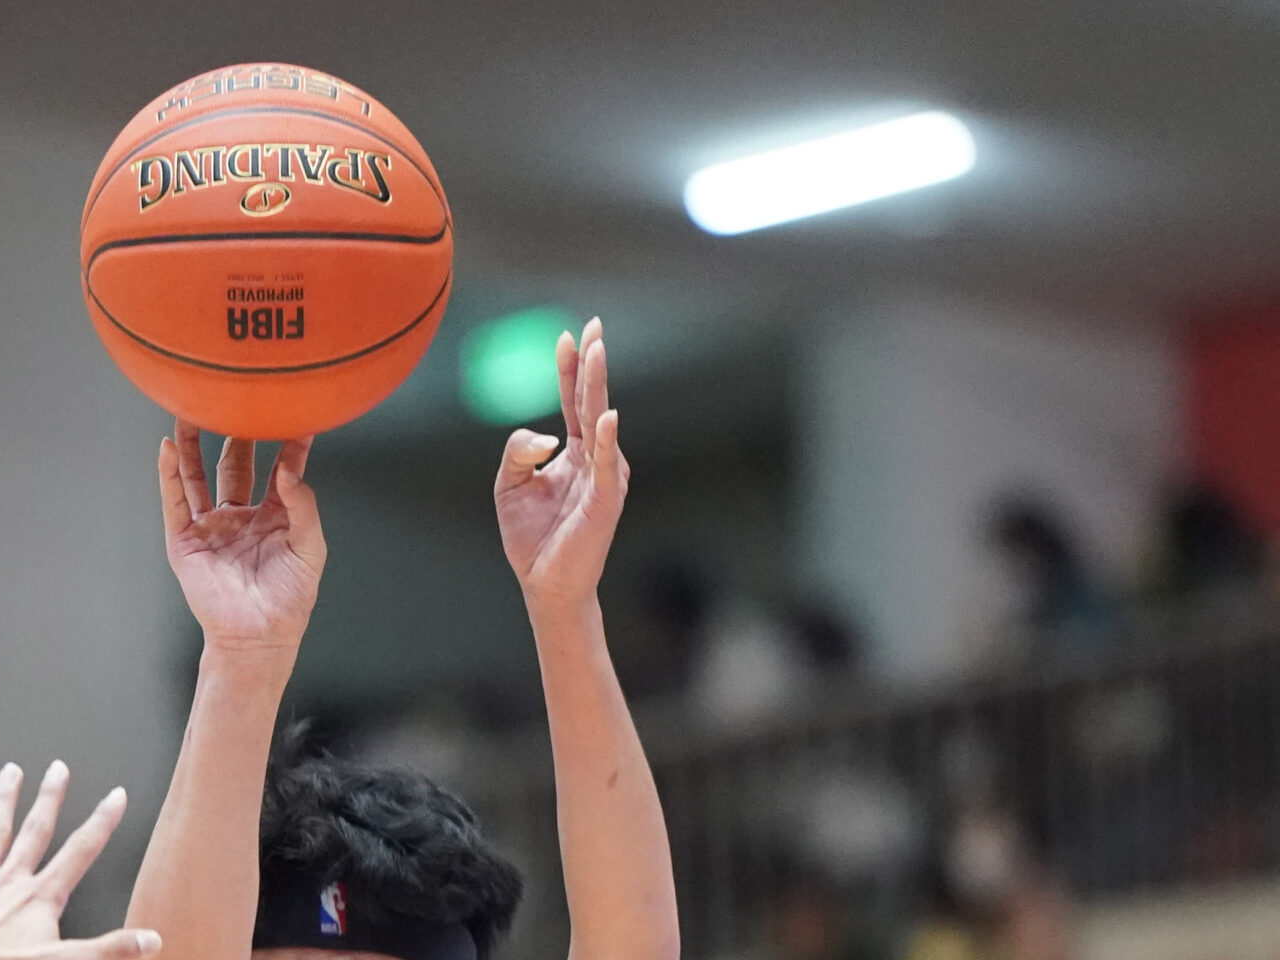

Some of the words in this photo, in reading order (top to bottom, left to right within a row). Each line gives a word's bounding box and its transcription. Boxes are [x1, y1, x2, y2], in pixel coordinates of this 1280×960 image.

[132, 143, 393, 212] SPALDING
[227, 286, 304, 301] APPROVED
[227, 307, 304, 340] FIBA
